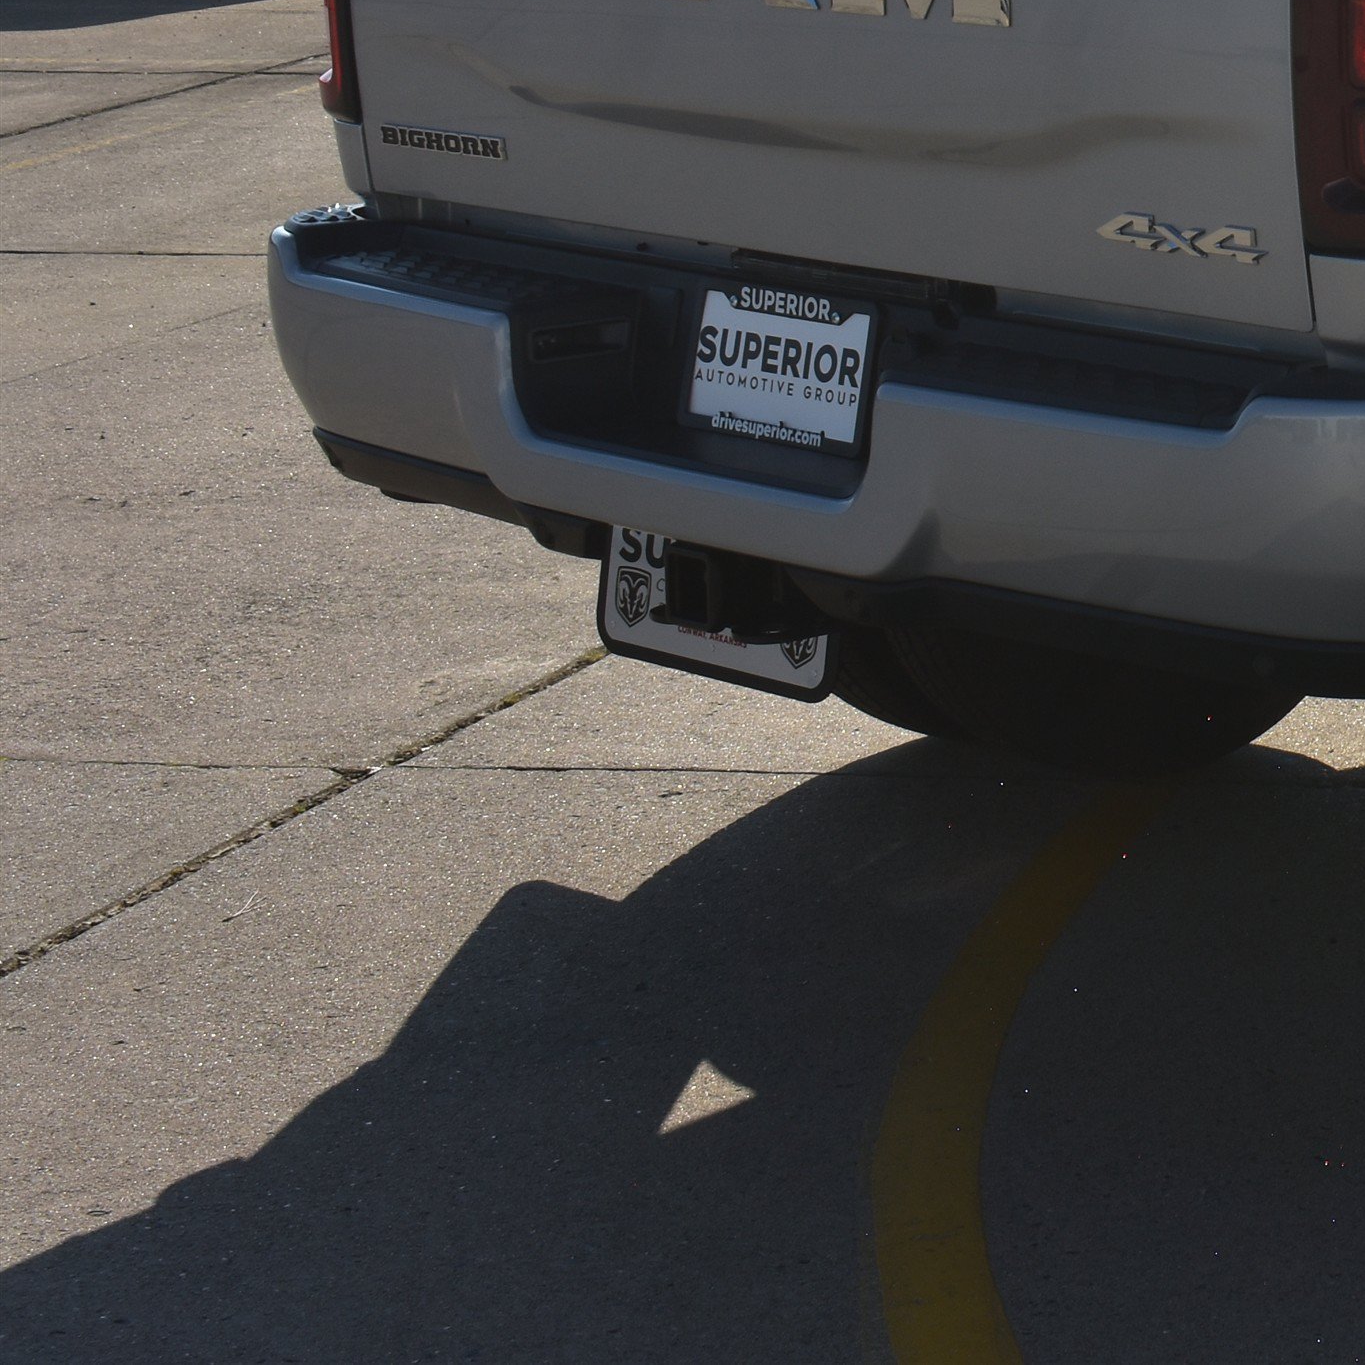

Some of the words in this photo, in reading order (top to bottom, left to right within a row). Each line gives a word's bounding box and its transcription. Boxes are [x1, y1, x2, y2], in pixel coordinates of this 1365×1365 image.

[380, 123, 504, 160] BIGHORN
[1095, 211, 1270, 265] 4x4
[740, 286, 831, 321] SUPERIOR
[696, 325, 861, 389] SUPERIOR
[694, 368, 795, 397] AUTOMOTIVE
[803, 385, 858, 407] GROUP
[711, 412, 822, 448] drivesuperior.com
